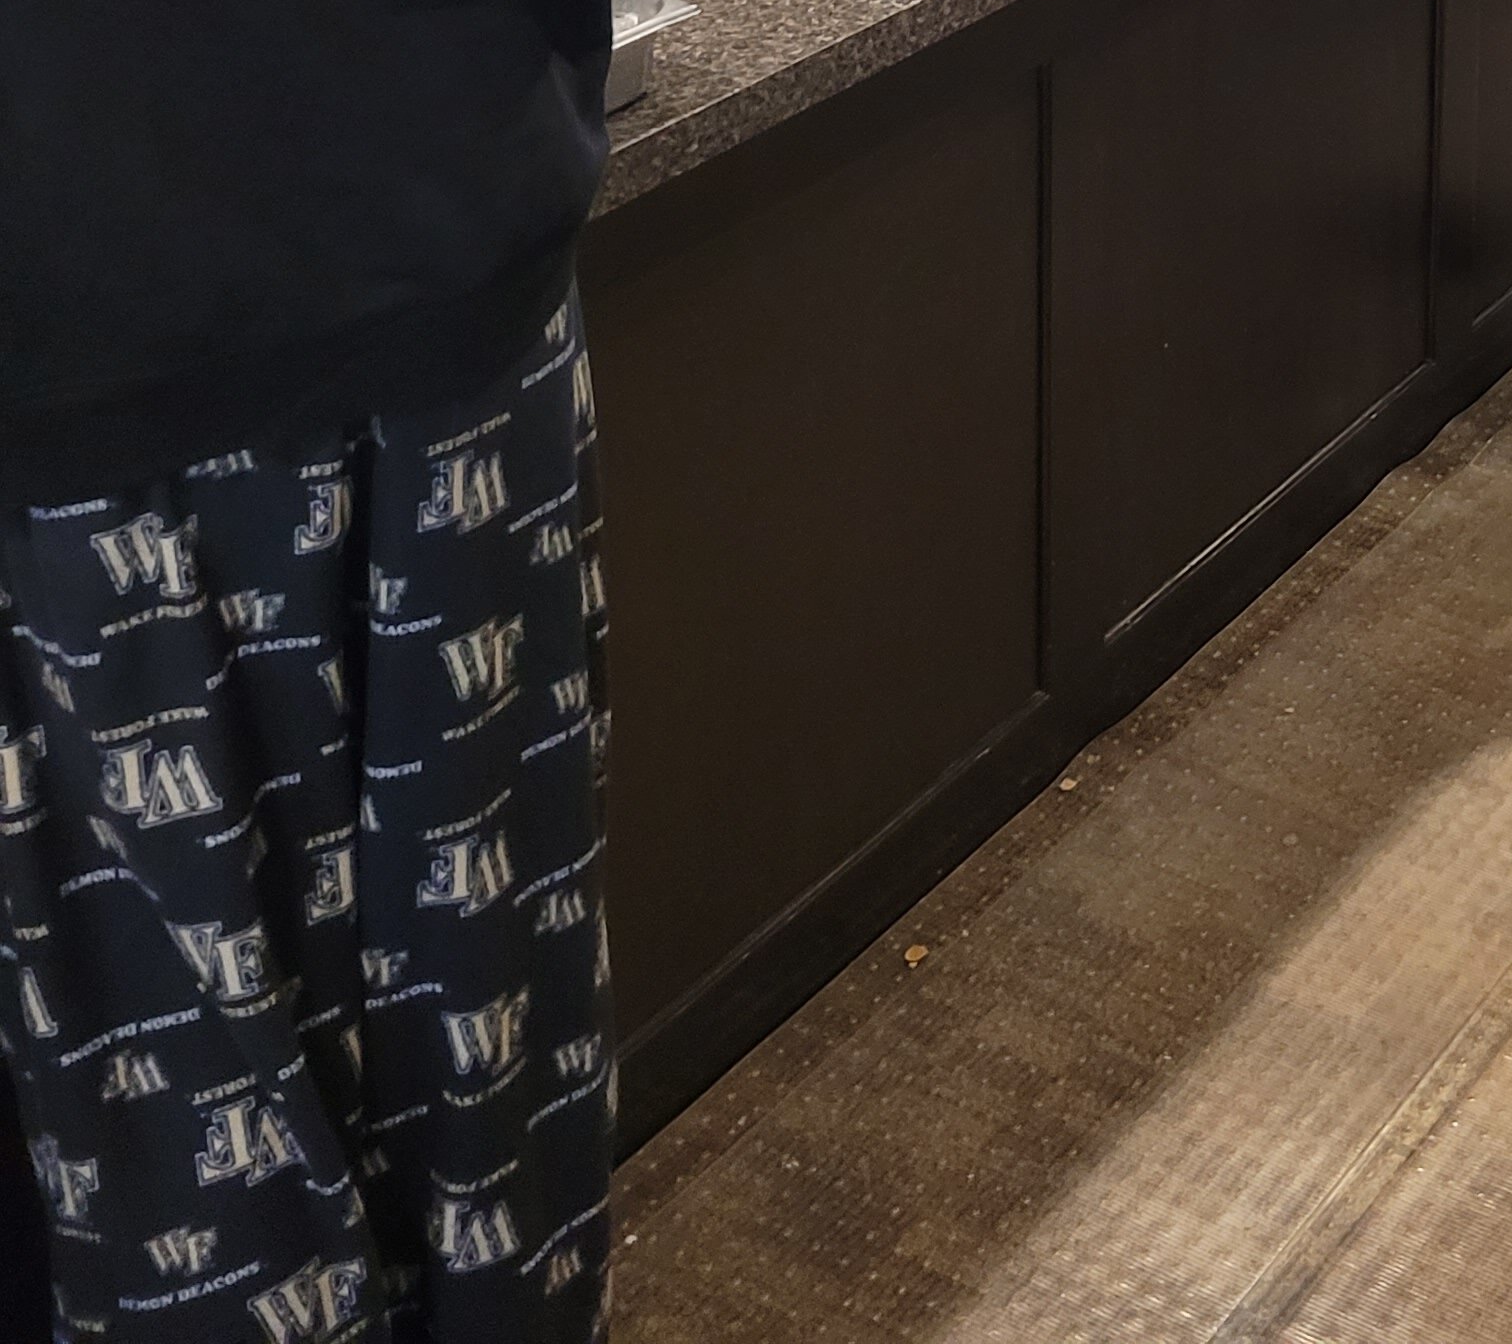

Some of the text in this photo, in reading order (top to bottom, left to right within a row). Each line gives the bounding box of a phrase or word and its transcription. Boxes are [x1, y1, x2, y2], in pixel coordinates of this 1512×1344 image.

[89, 512, 198, 599] WF
[438, 613, 525, 702] WF
[102, 738, 224, 829] WF
[440, 983, 530, 1077] WF
[177, 1260, 262, 1303] DEACONS
[246, 1255, 367, 1344] WF
